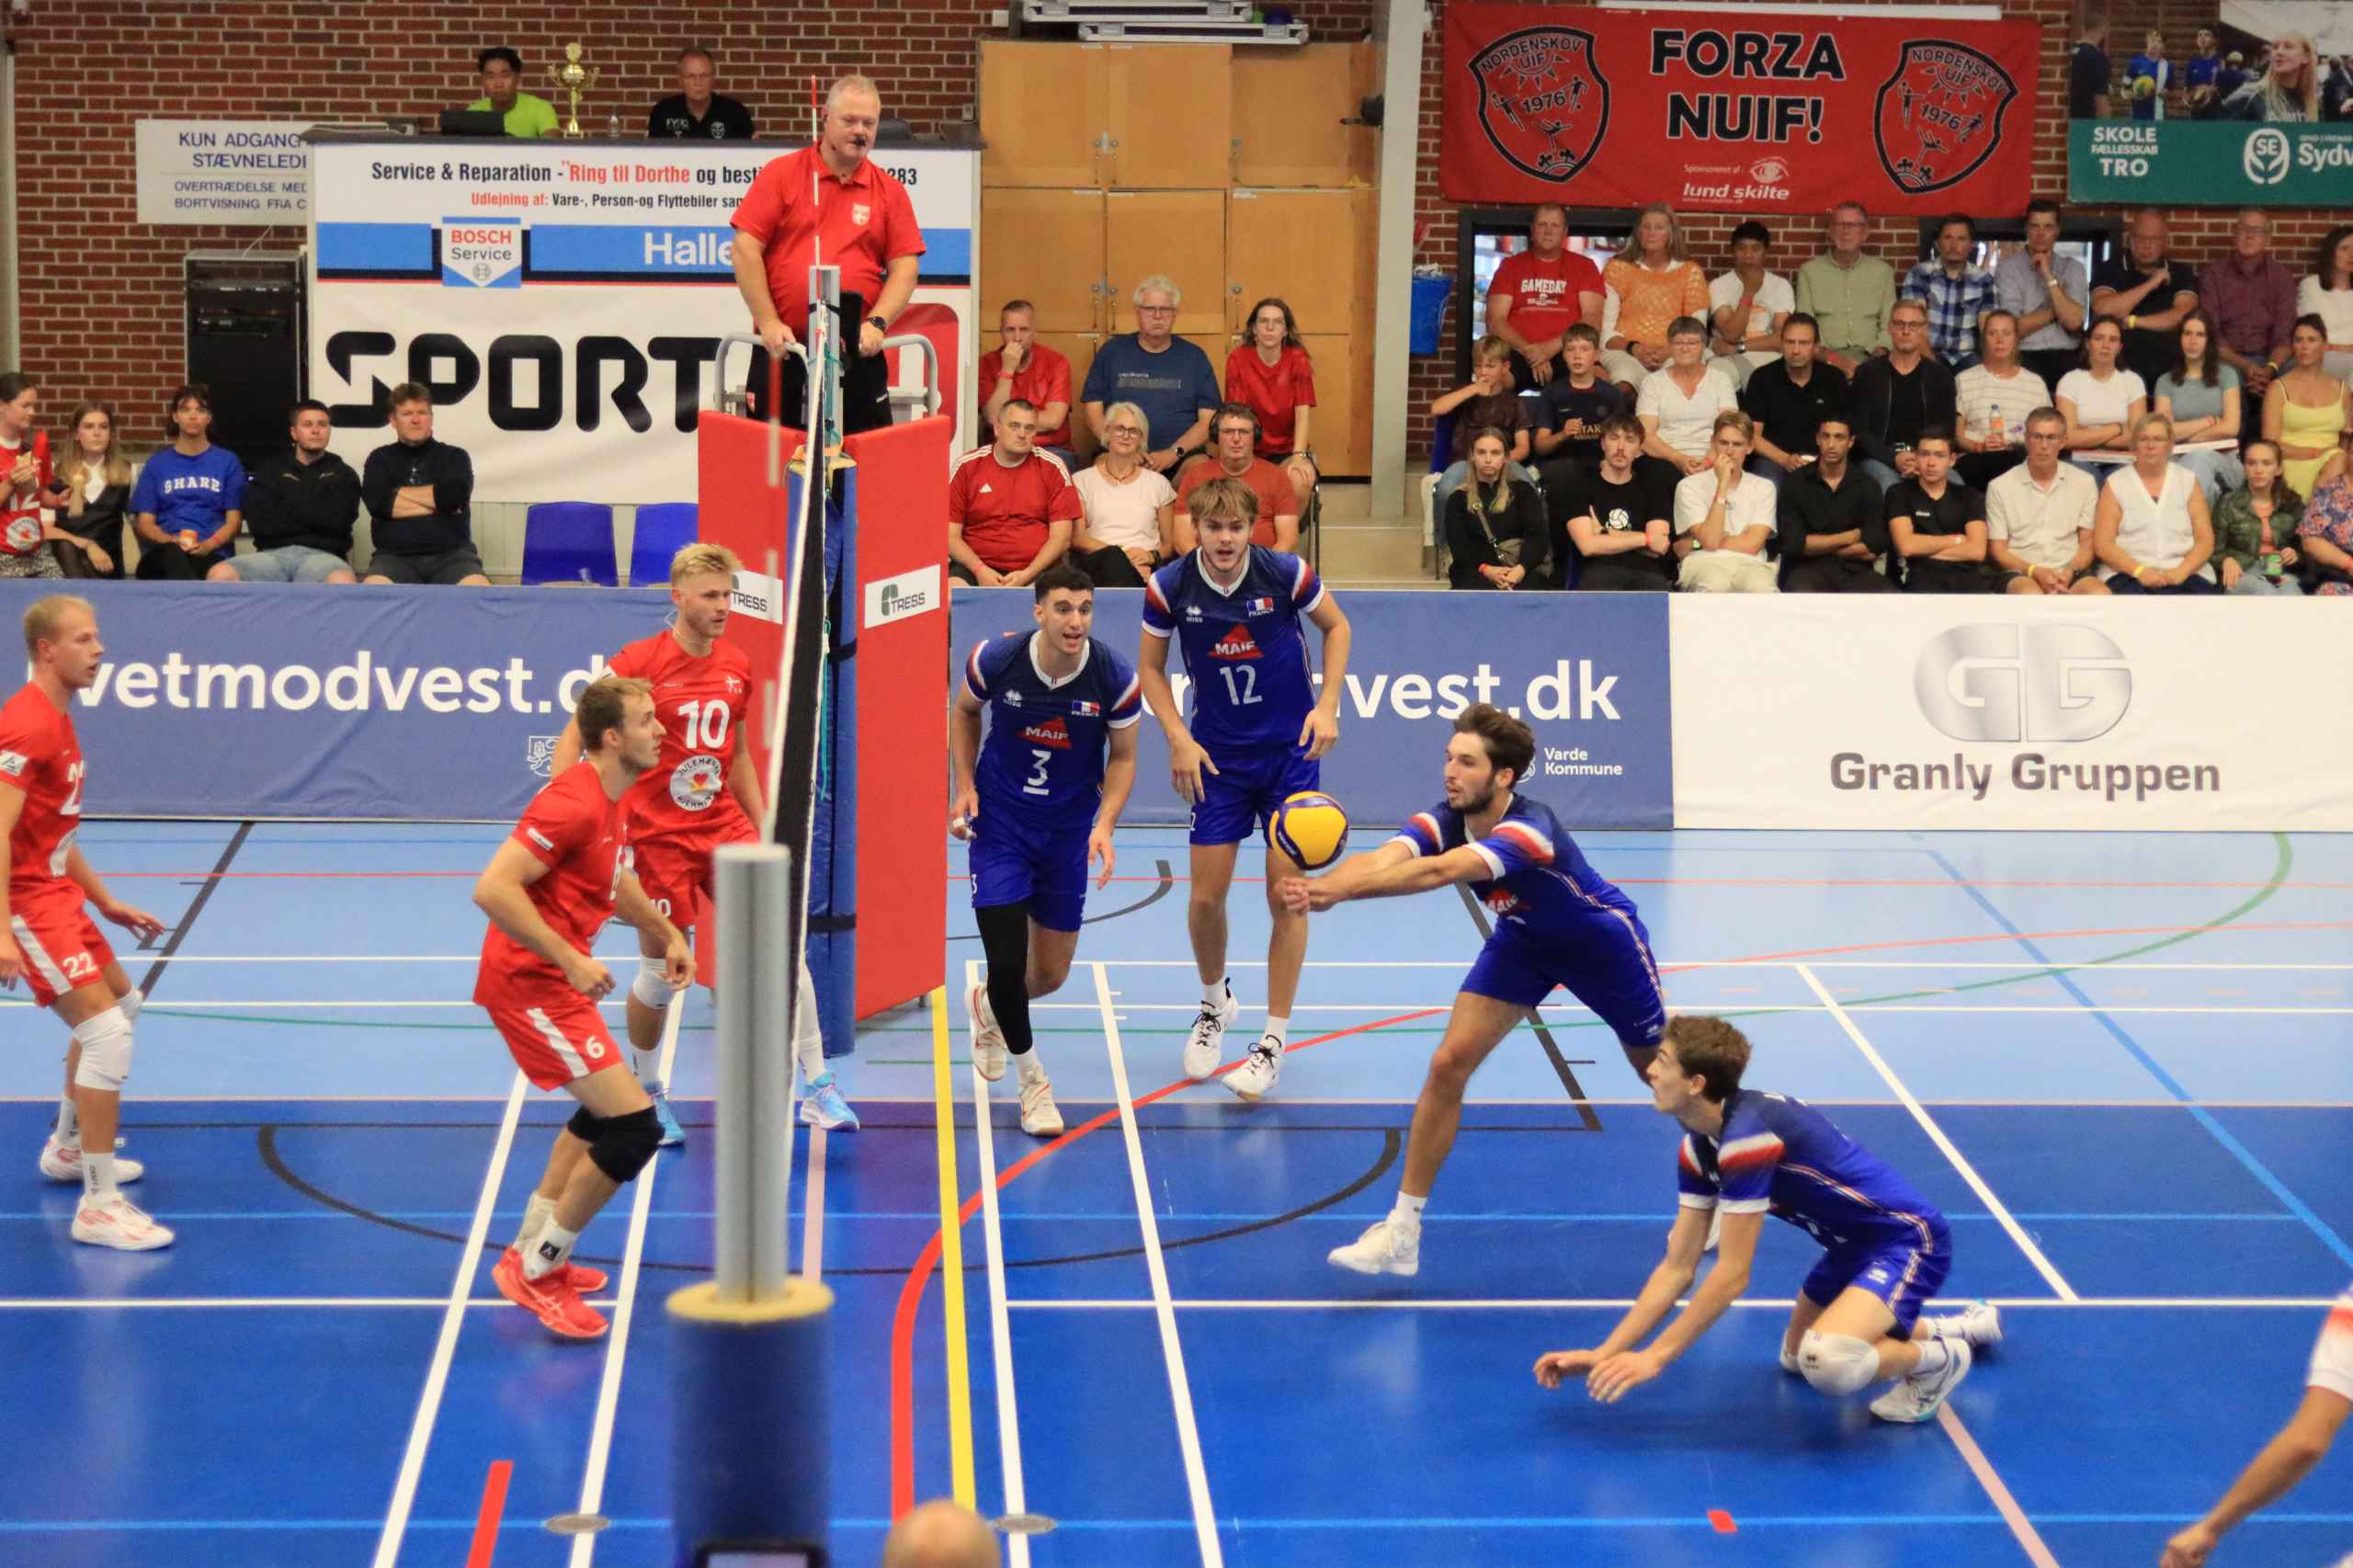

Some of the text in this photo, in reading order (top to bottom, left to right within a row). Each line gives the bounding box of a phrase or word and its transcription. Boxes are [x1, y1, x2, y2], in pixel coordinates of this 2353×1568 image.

[1480, 36, 1582, 74] NORDENSKOV
[1518, 52, 1546, 69] UIF
[1651, 28, 1847, 80] FORZA
[1912, 50, 2005, 95] NORDENSKOV
[1945, 68, 1972, 85] UIF
[1522, 91, 1567, 114] 1976
[1666, 92, 1824, 144] NUIF!
[1920, 103, 1961, 131] 1976
[178, 132, 301, 148] KUN ADGANG
[2094, 127, 2156, 142] SKOLE
[2256, 139, 2279, 155] SE
[371, 162, 435, 180] Service
[441, 163, 453, 180] &
[460, 164, 551, 183] Reparation
[613, 165, 629, 183] til
[635, 165, 690, 183] Dorthe
[697, 170, 716, 186] og
[2099, 158, 2148, 176] TRO
[175, 181, 276, 192] OVERTRÆDELSE
[1684, 183, 1730, 198] lund
[1733, 185, 1790, 200] skilte
[175, 198, 260, 210] BORTVISNING
[267, 199, 291, 210] FRA
[471, 192, 529, 206] Udlejning
[532, 194, 549, 205] af:
[552, 193, 588, 208] Vare-,
[658, 195, 718, 209] Flyttebiler
[450, 230, 512, 244] BOSCH
[450, 247, 512, 261] Service
[1521, 278, 1567, 294] GAMEDAY
[325, 331, 722, 434] SPORT
[165, 476, 221, 494] SHARE
[733, 591, 767, 612] TRESS
[891, 592, 926, 613] TRESS
[1215, 641, 1256, 654] MAIF
[1219, 665, 1263, 705] 12
[678, 699, 730, 749] 10
[1025, 726, 1070, 740] MAIF
[1544, 747, 1588, 761] Varde
[1028, 749, 1051, 787] 3
[1545, 762, 1623, 776] Kommune
[1830, 752, 2221, 801] Granly Gruppen
[63, 951, 97, 979] 22
[585, 1035, 605, 1059] 6
